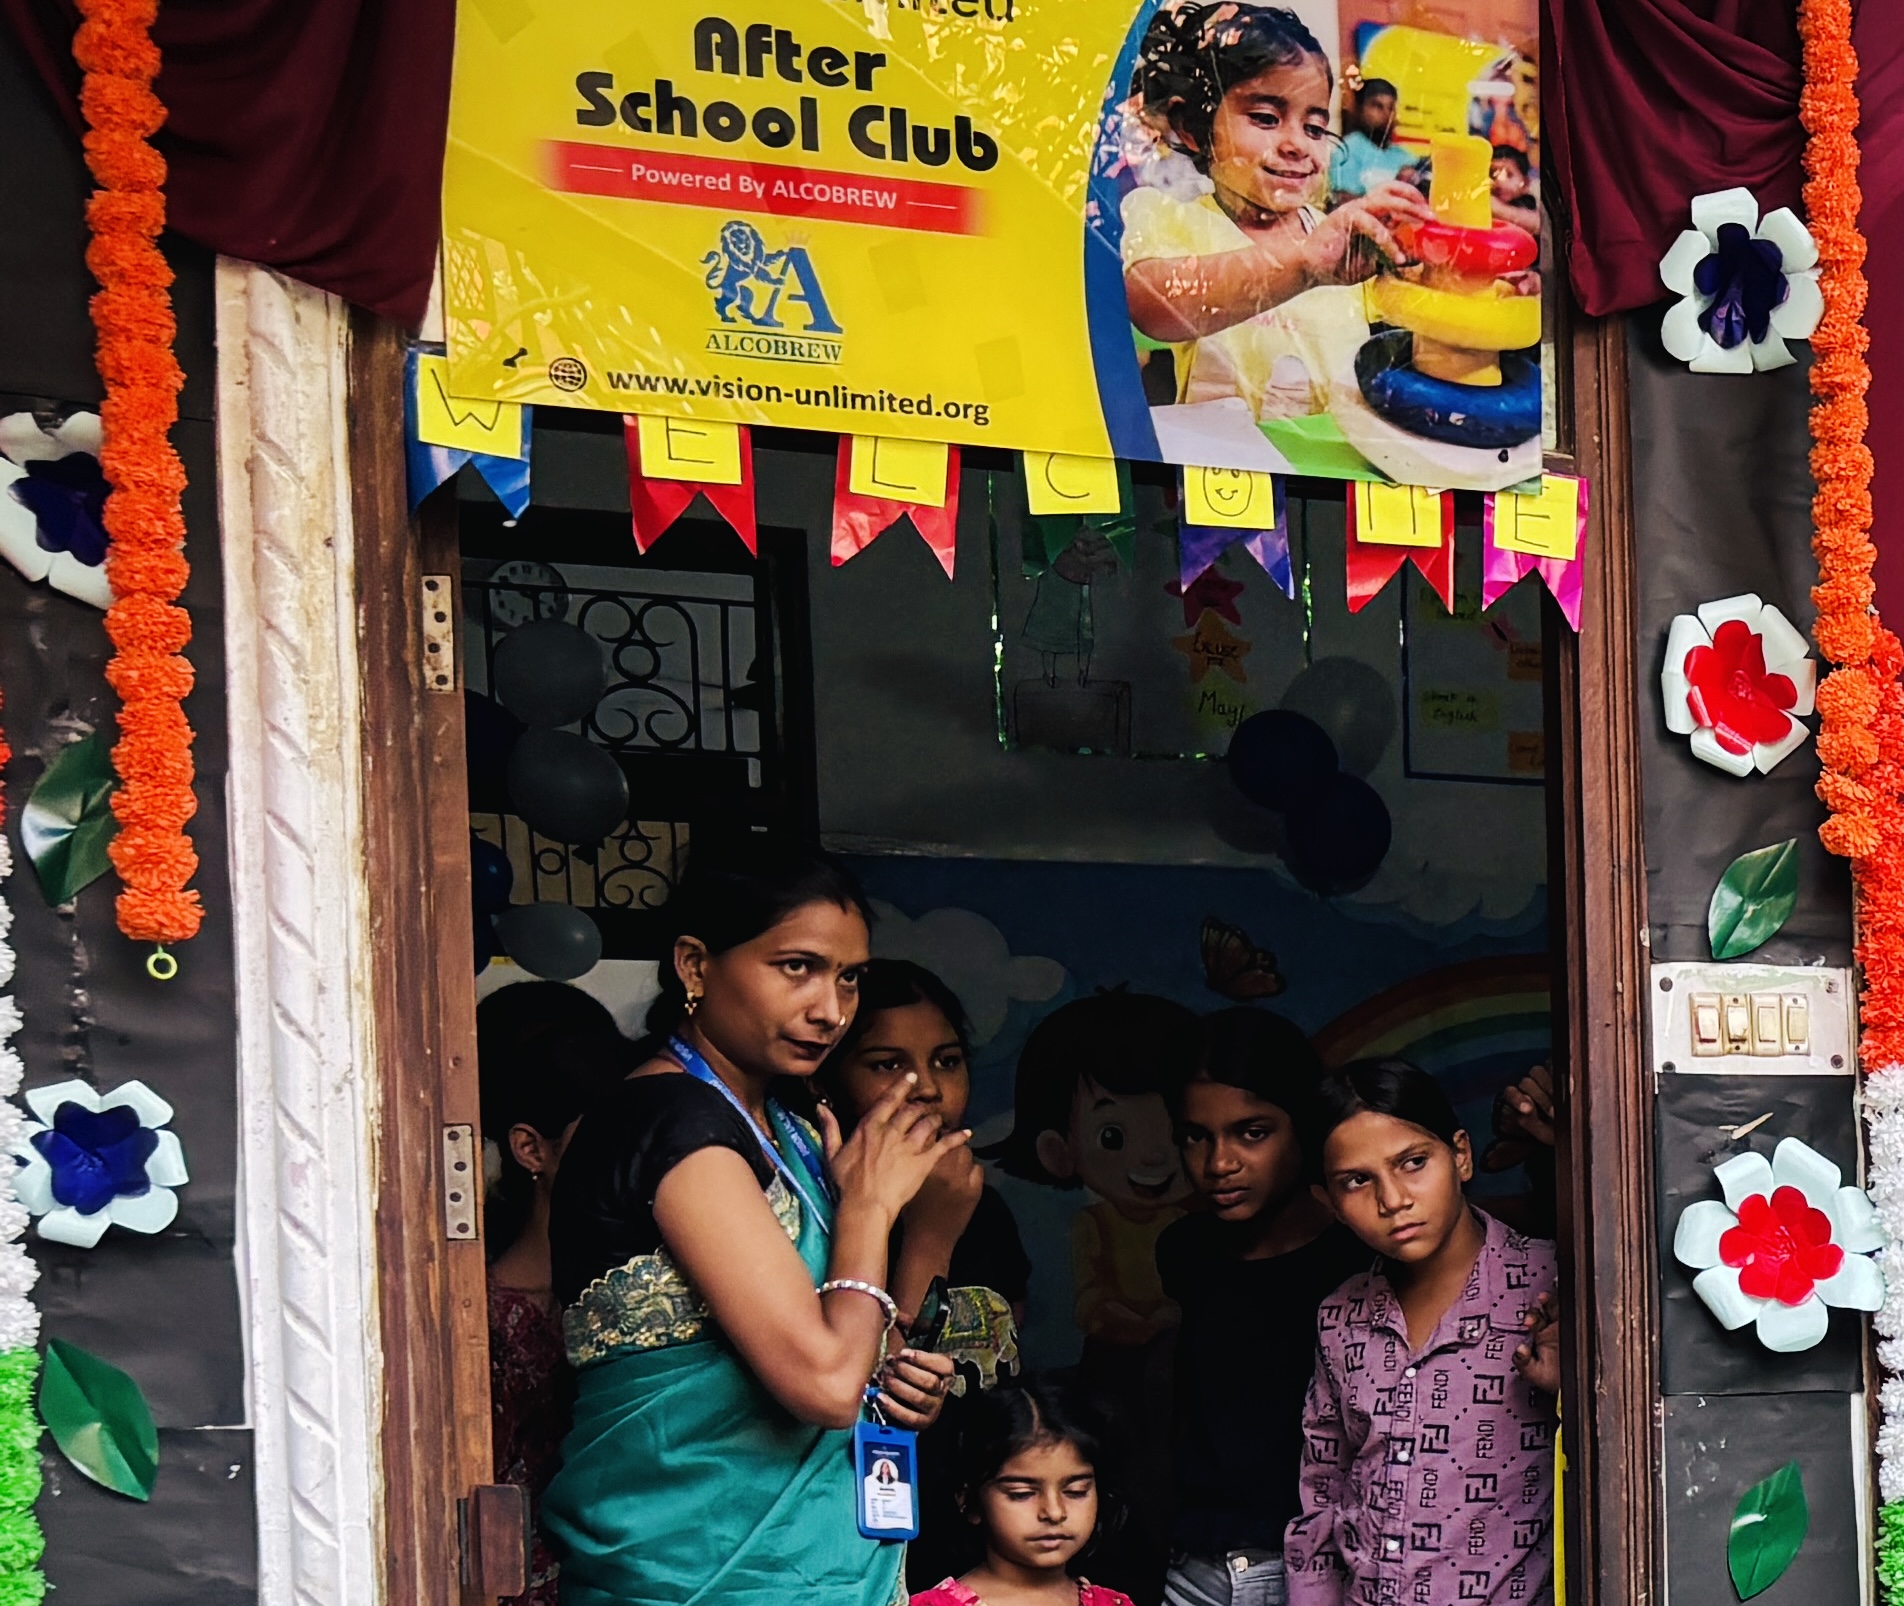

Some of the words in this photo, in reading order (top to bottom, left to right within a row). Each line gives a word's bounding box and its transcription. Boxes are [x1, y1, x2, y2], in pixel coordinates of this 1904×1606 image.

[694, 16, 888, 92] After
[575, 71, 819, 153] School
[848, 105, 999, 171] Club
[631, 163, 731, 190] Powered
[739, 176, 765, 198] By
[772, 180, 897, 209] ALCOBREW
[705, 333, 842, 361] ALCOBREW
[606, 369, 990, 425] www.vision-unlimited.org
[1198, 690, 1238, 727] May
[1431, 1369, 1450, 1409] FENDI
